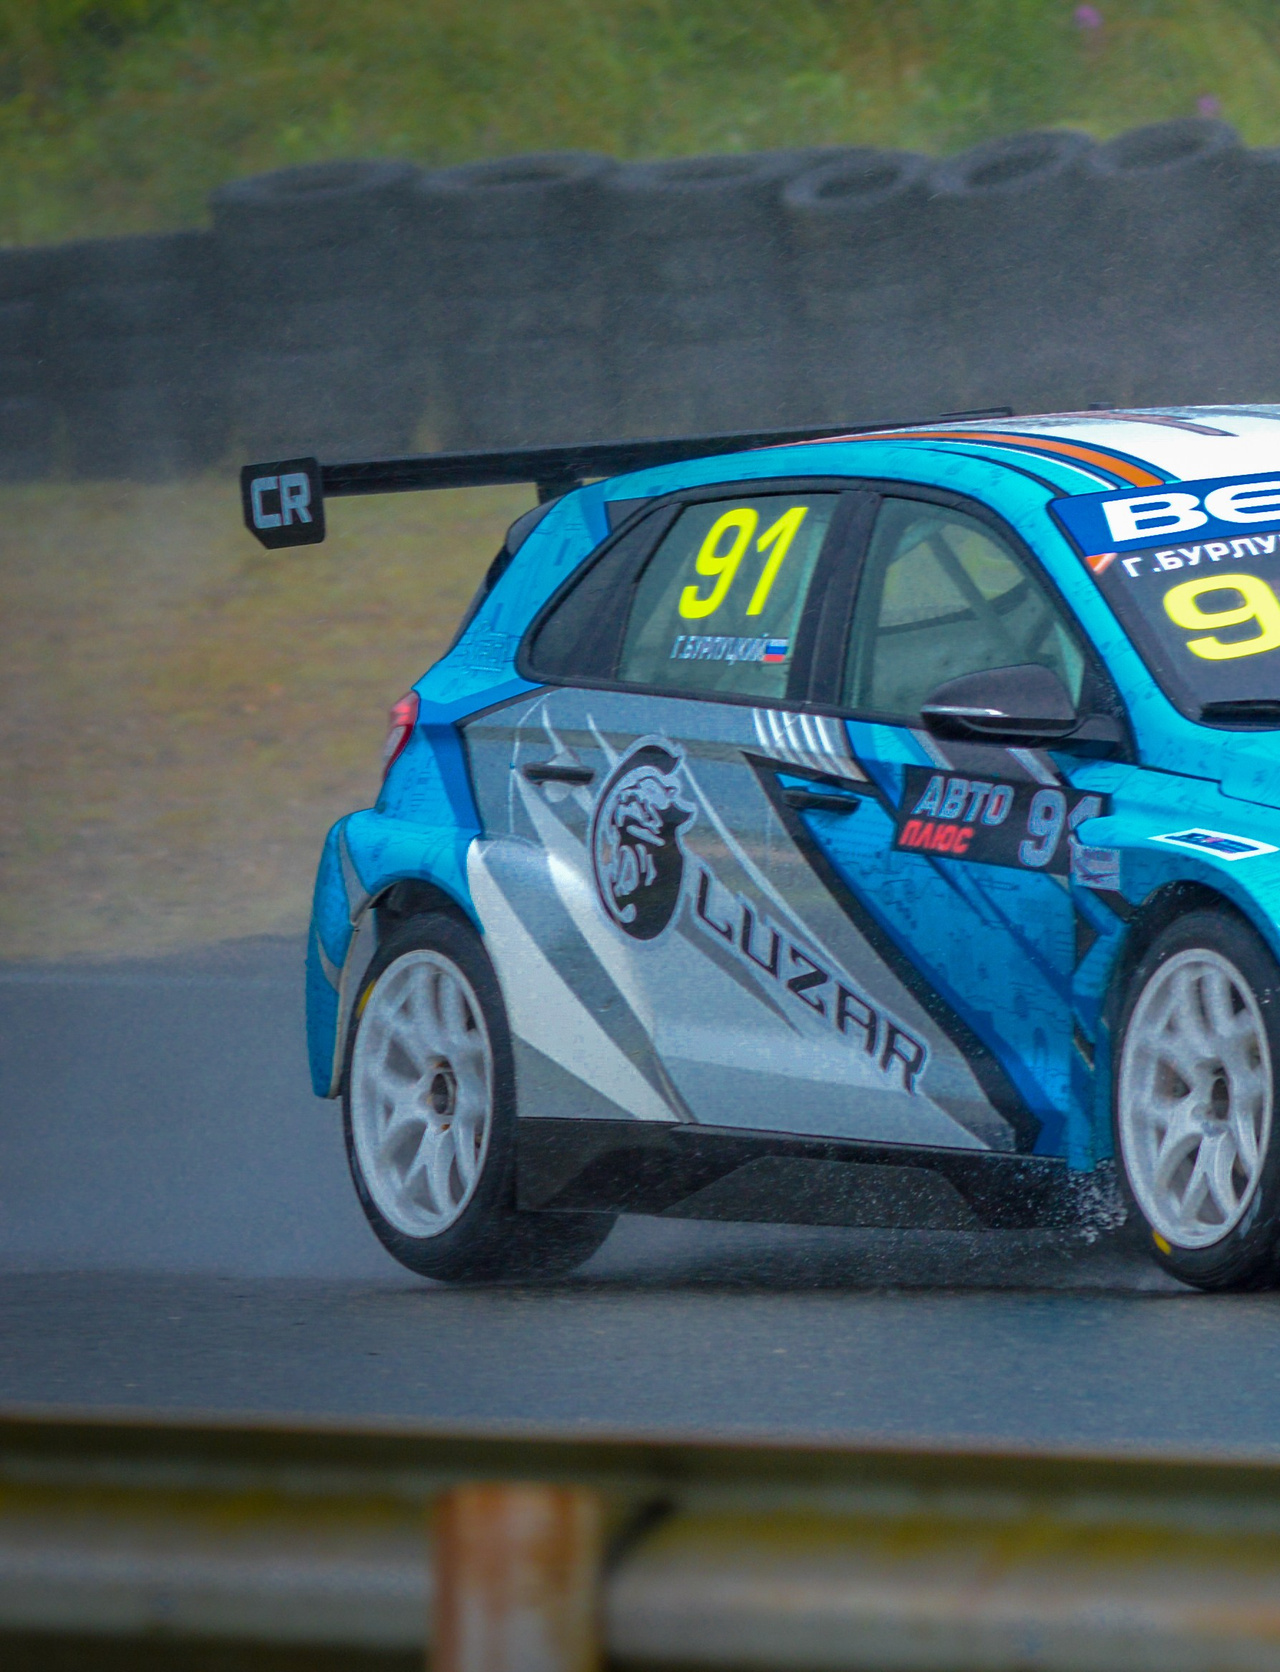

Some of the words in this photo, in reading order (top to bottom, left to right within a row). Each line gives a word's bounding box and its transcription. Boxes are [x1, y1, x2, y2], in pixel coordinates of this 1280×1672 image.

[251, 472, 313, 529] CR
[679, 506, 809, 619] 91
[911, 775, 1015, 826] АВТО
[898, 819, 975, 854] ПЛЮС
[696, 869, 926, 1097] LUZAR
